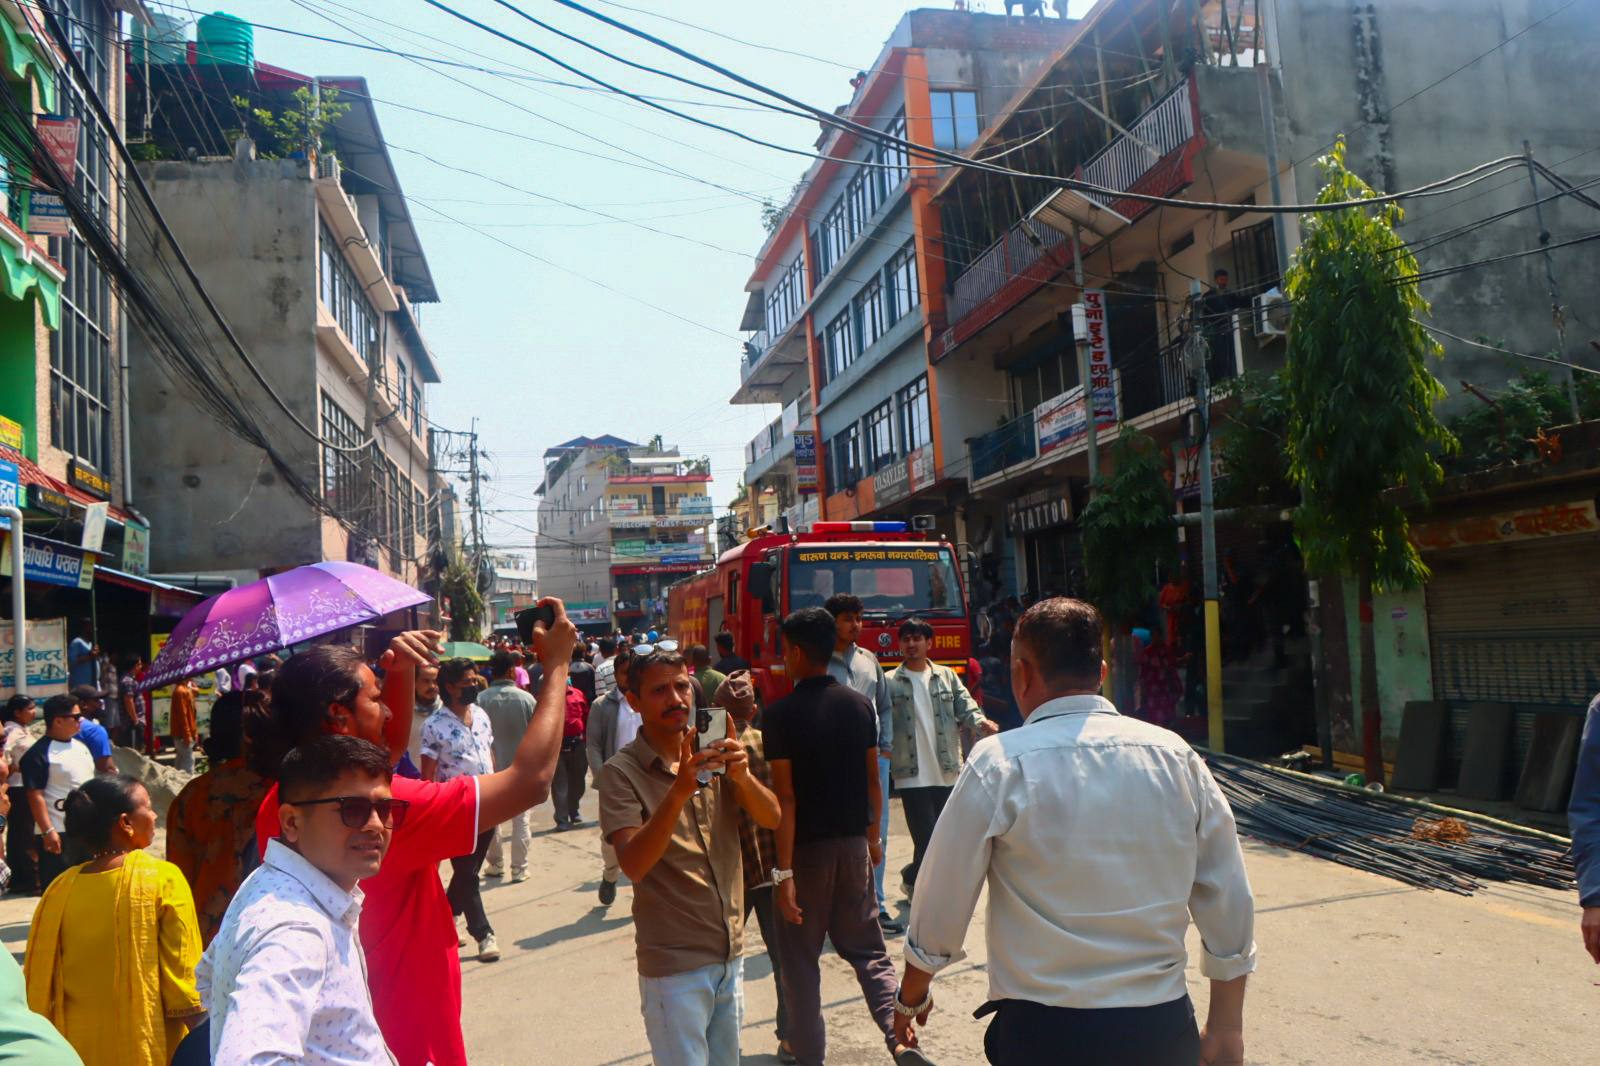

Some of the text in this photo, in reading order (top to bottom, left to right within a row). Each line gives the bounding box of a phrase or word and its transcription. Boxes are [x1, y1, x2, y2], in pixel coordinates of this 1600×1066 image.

[1019, 498, 1068, 531] TATTOO
[682, 519, 706, 527] HOUSE
[887, 549, 939, 560] नगरपालिका
[56, 554, 80, 574] पसल
[935, 636, 961, 648] FIRE
[25, 648, 63, 663] सेन्टर
